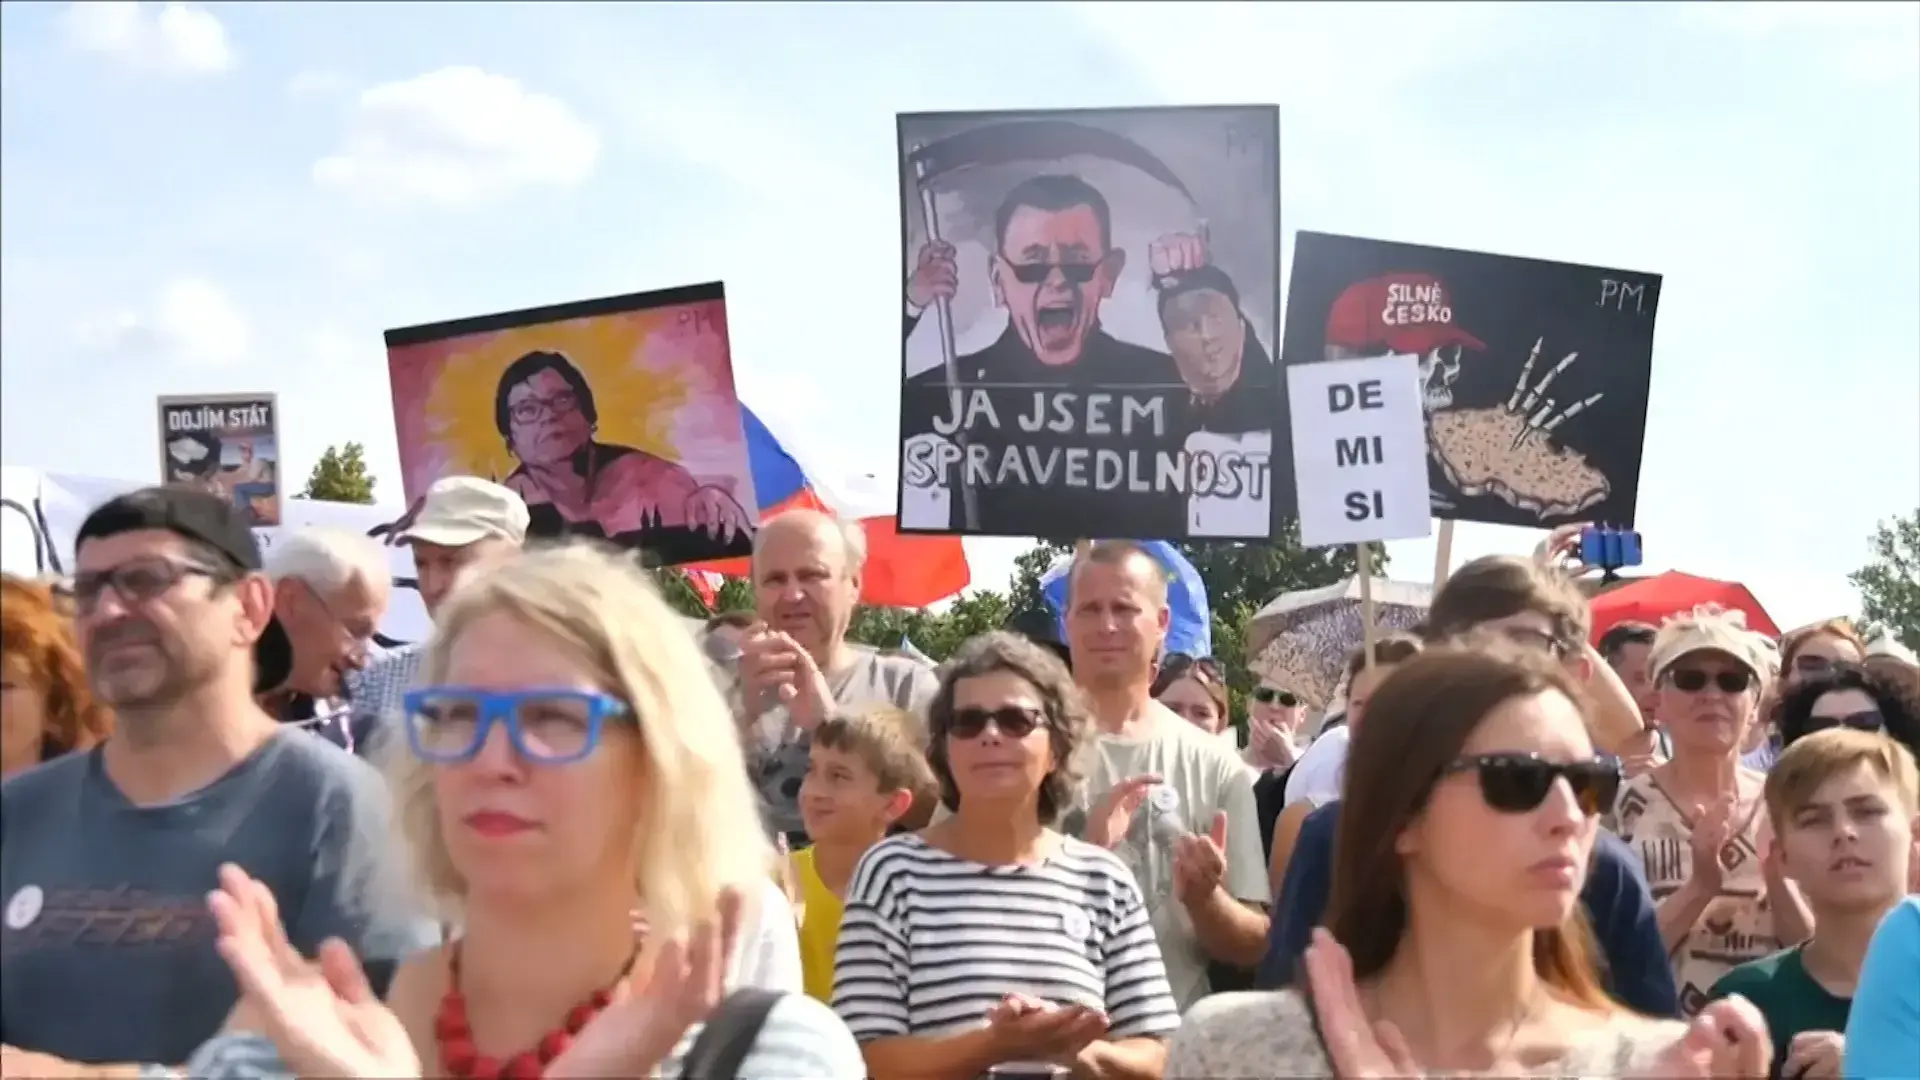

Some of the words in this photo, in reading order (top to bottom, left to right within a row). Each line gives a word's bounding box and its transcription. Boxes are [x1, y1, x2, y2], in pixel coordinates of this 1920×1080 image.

[932, 368, 1001, 435] JÁ
[1018, 390, 1165, 437] JSEM
[1327, 379, 1384, 413] DE
[168, 404, 225, 431] DOJÍM
[228, 403, 269, 429] STÁT
[1335, 435, 1384, 468] MI
[903, 440, 1272, 500] SPRAVEDLNOST
[1344, 490, 1384, 522] SI
